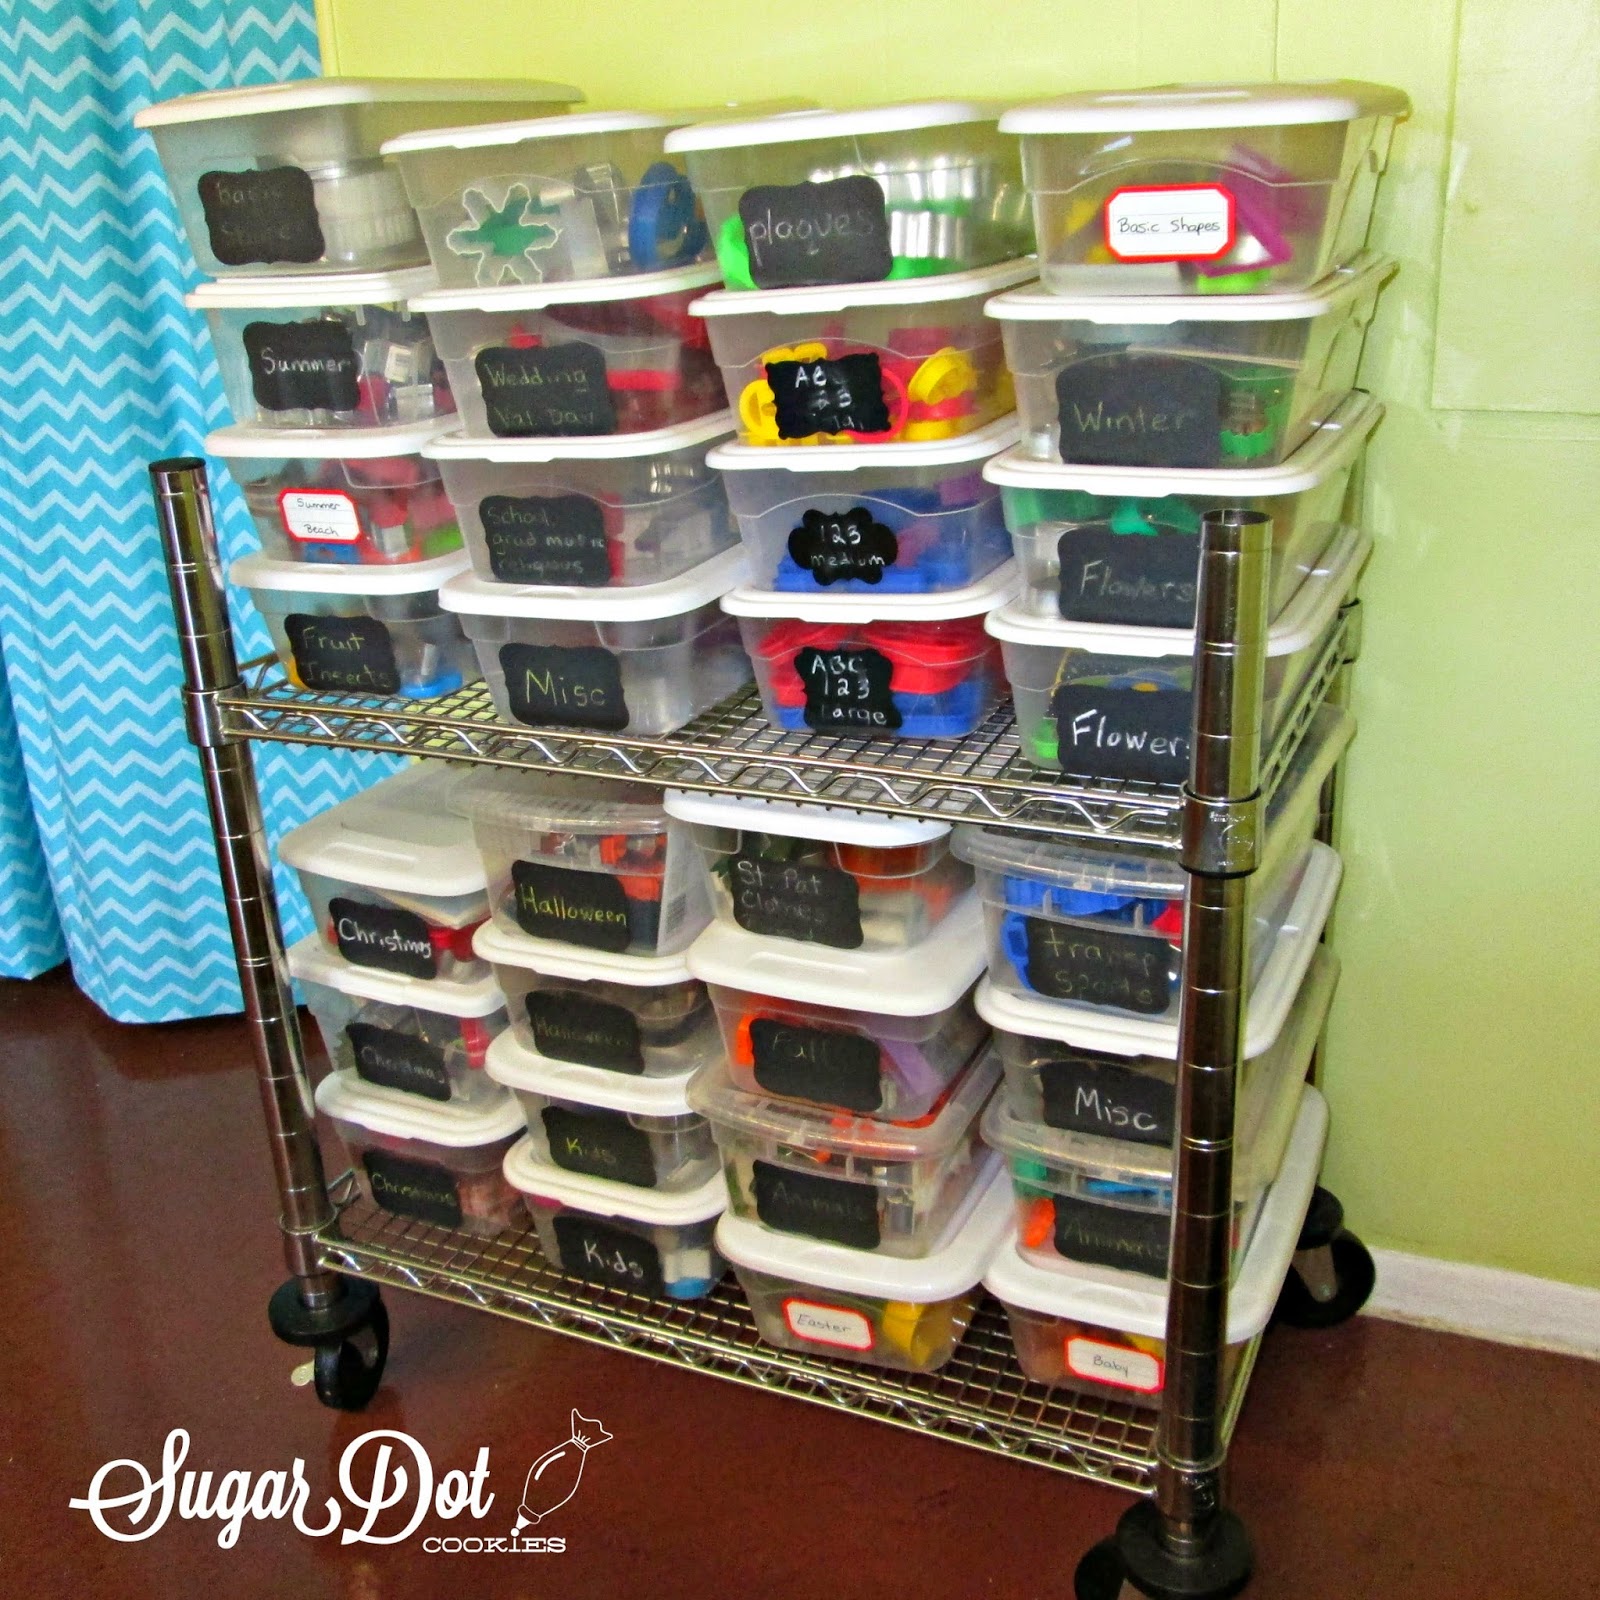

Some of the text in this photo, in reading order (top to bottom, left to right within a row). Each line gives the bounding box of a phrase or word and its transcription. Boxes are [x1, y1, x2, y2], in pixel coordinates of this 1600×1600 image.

[1119, 215, 1160, 233] Basic
[261, 347, 352, 375] Summer
[483, 363, 589, 393] Wedding
[795, 364, 850, 390] AB
[1073, 401, 1188, 432] Winter
[297, 496, 341, 511] Summer
[304, 523, 340, 537] Beach
[819, 523, 861, 545] 123
[810, 551, 887, 568] medium
[1079, 559, 1196, 603] Flowers
[303, 626, 366, 652] Fruit
[810, 654, 863, 675] ABC
[525, 667, 607, 708] Misc
[819, 703, 887, 726] large
[1072, 708, 1190, 758] Flower
[782, 867, 822, 896] Pat
[519, 883, 625, 926] Halloween
[339, 917, 435, 960] Christmas
[772, 1030, 828, 1064] Fall
[1075, 1084, 1161, 1131] Misc
[564, 1136, 615, 1165] Kids
[582, 1240, 643, 1278] Kids
[798, 1313, 850, 1333] Easter
[1094, 1354, 1129, 1377] Baby
